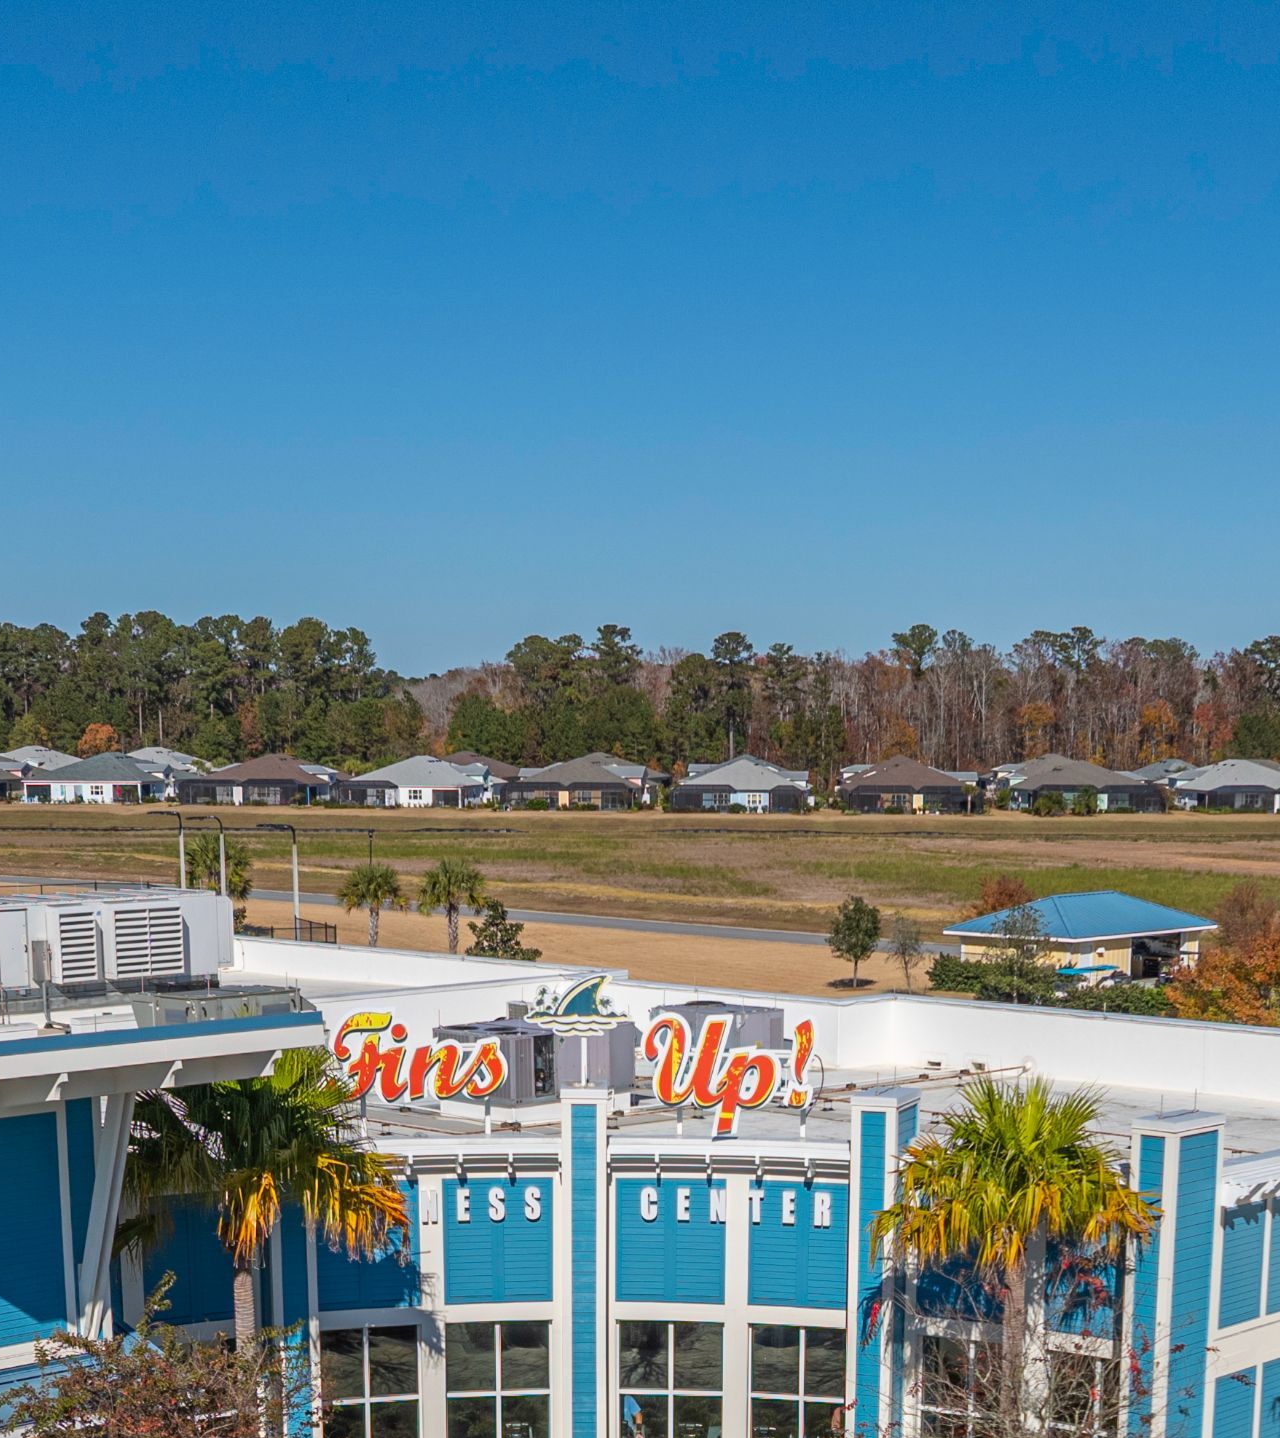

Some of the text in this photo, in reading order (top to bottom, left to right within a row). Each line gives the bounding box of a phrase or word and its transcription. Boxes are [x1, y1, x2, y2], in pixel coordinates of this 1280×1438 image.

[328, 1008, 816, 1136] Fins Up!
[420, 1185, 832, 1229] NESS CENTER
